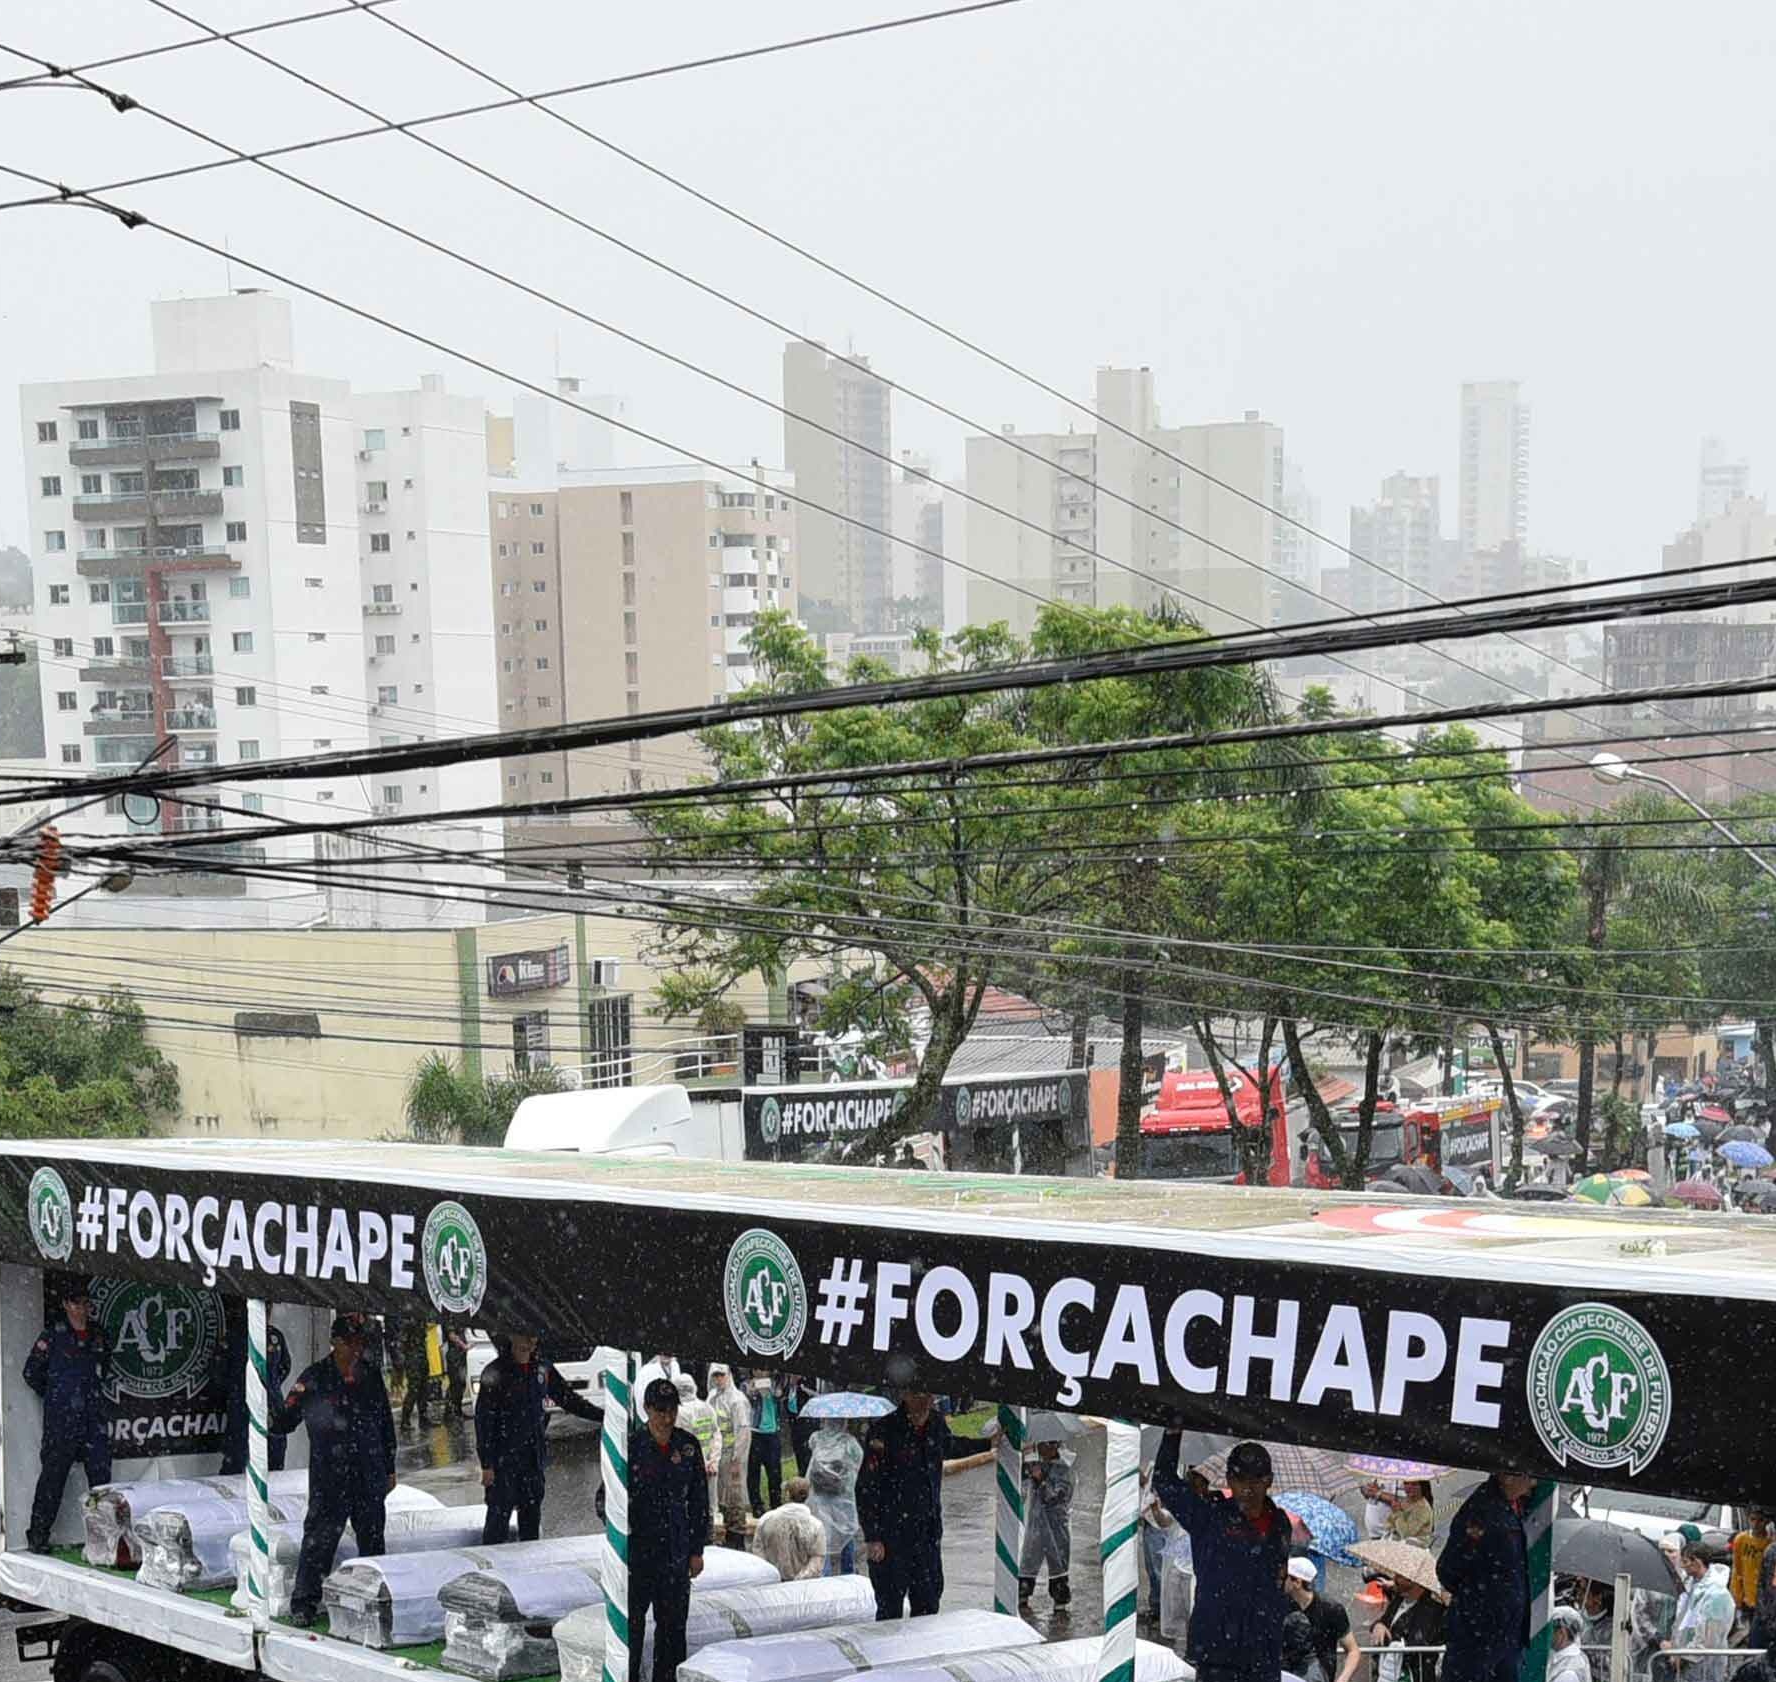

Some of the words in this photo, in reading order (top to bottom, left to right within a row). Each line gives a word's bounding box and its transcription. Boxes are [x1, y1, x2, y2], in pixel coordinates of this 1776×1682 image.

[972, 1085, 1058, 1121] #FORÇACHAPE
[76, 1186, 415, 1290] #FORÇACHAPE
[815, 1256, 1510, 1430] #FORÇACHAPE
[1554, 1313, 1650, 1358] CHAPECOENSE
[1642, 1354, 1659, 1379] DE
[107, 1412, 227, 1447] RÇACHA
[1633, 1380, 1662, 1451] FUTEBOL
[1586, 1431, 1608, 1444] 1973
